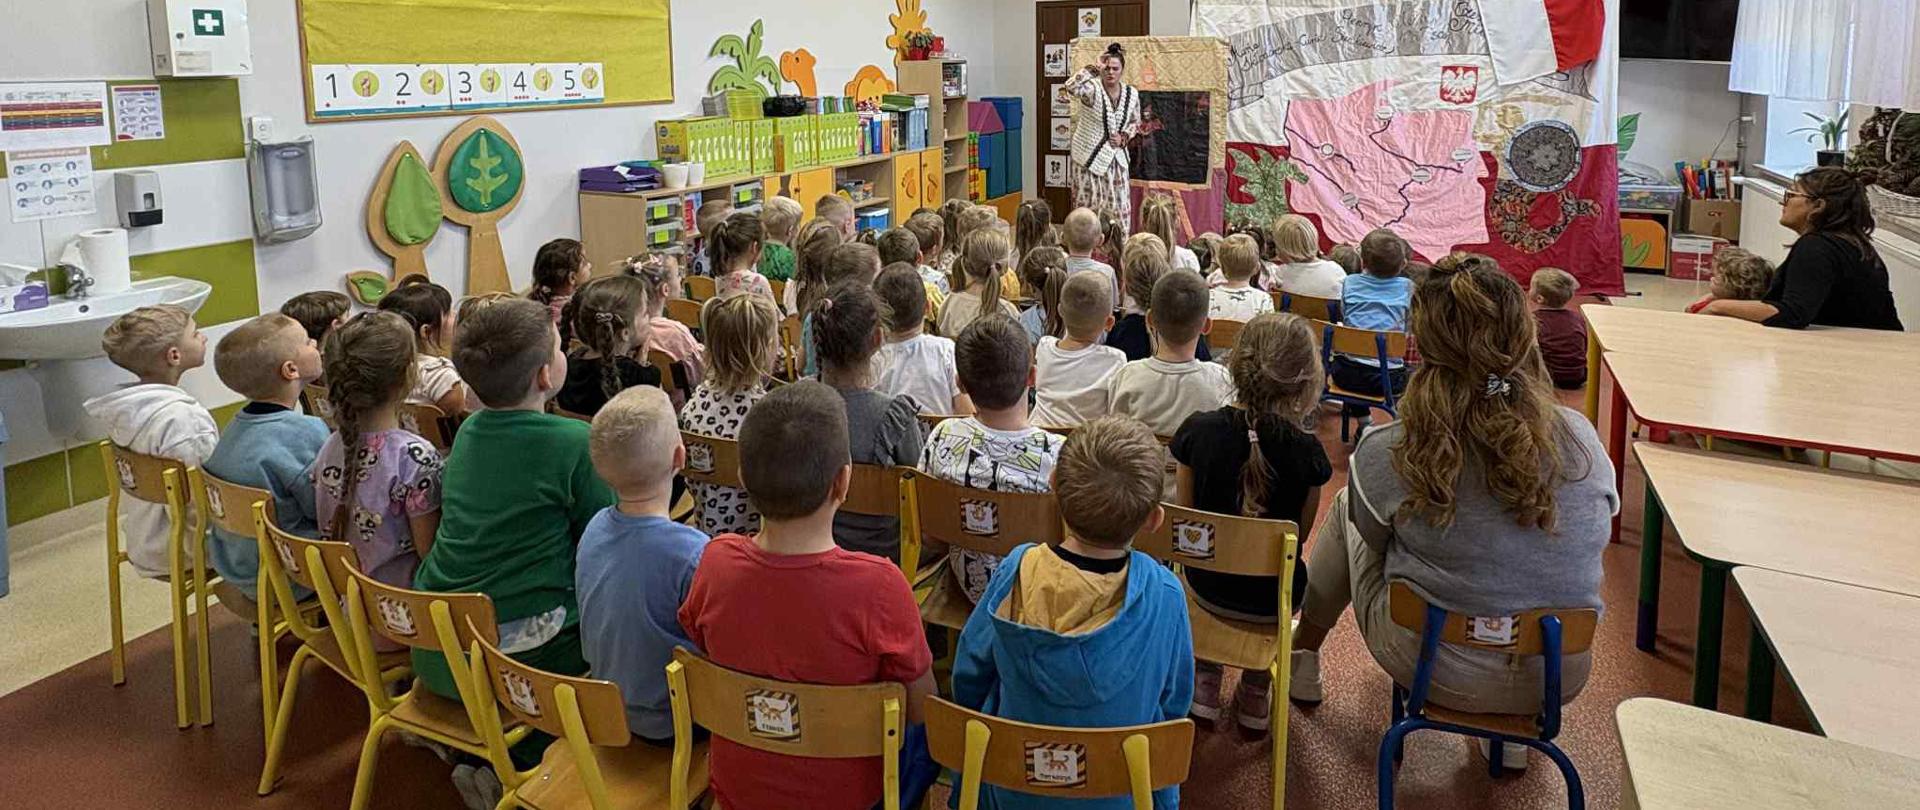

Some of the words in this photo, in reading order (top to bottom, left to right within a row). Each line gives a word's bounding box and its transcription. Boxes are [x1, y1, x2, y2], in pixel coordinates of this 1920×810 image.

[325, 73, 338, 99] 1
[395, 72, 412, 97] 2
[458, 71, 473, 94] 3
[513, 70, 528, 92] 4
[564, 69, 576, 90] 5
